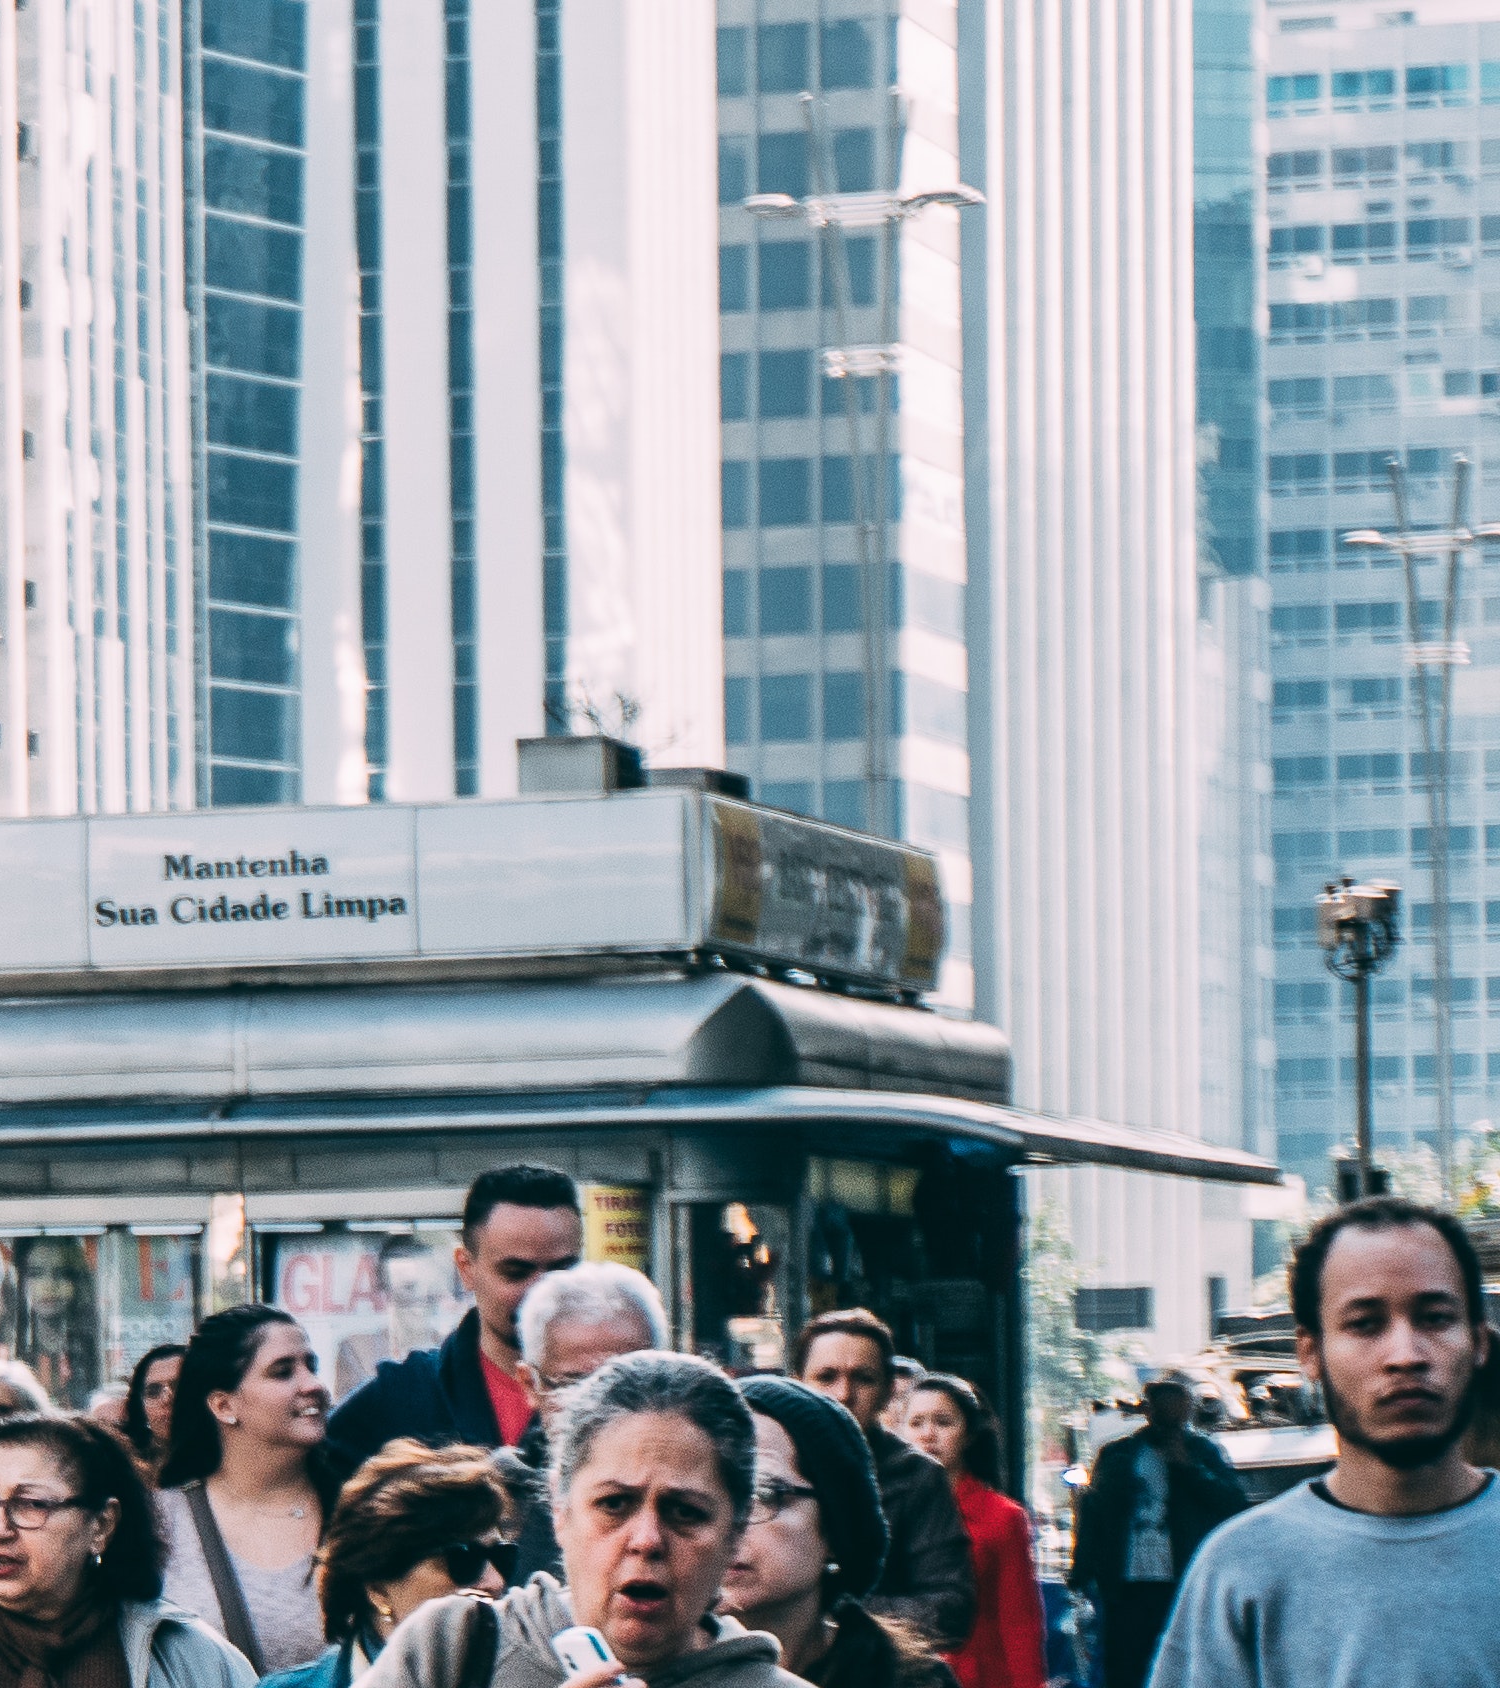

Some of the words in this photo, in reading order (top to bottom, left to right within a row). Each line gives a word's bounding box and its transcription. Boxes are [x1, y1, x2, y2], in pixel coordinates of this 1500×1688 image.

[164, 849, 329, 880] Mantenha
[95, 899, 160, 927] Sua
[170, 894, 289, 924] Cidade
[300, 891, 407, 922] Limpa
